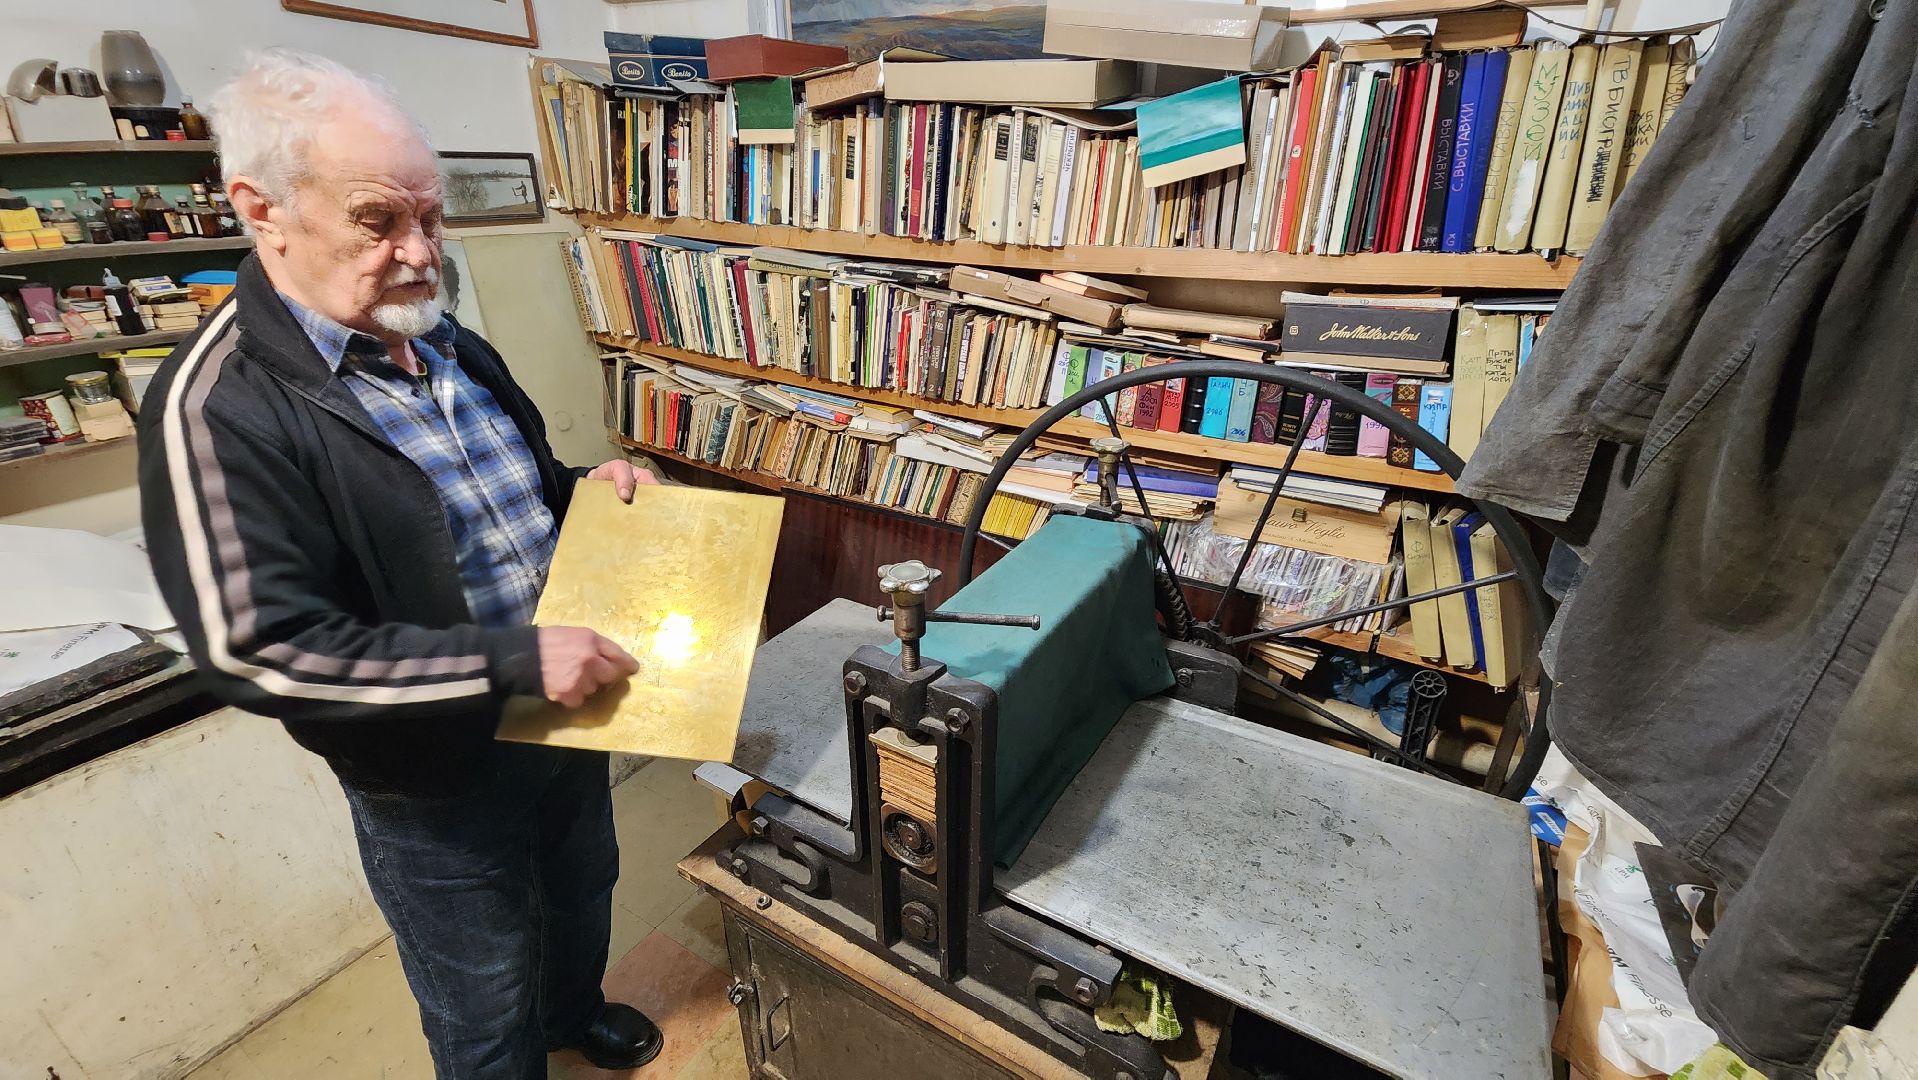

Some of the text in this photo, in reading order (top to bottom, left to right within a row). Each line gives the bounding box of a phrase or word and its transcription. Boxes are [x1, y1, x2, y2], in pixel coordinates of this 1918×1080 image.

[667, 67, 691, 77] Benito
[1319, 322, 1352, 341] John
[1350, 324, 1389, 341] Walker
[1393, 326, 1422, 342] Sons
[1303, 519, 1347, 539] Veglio
